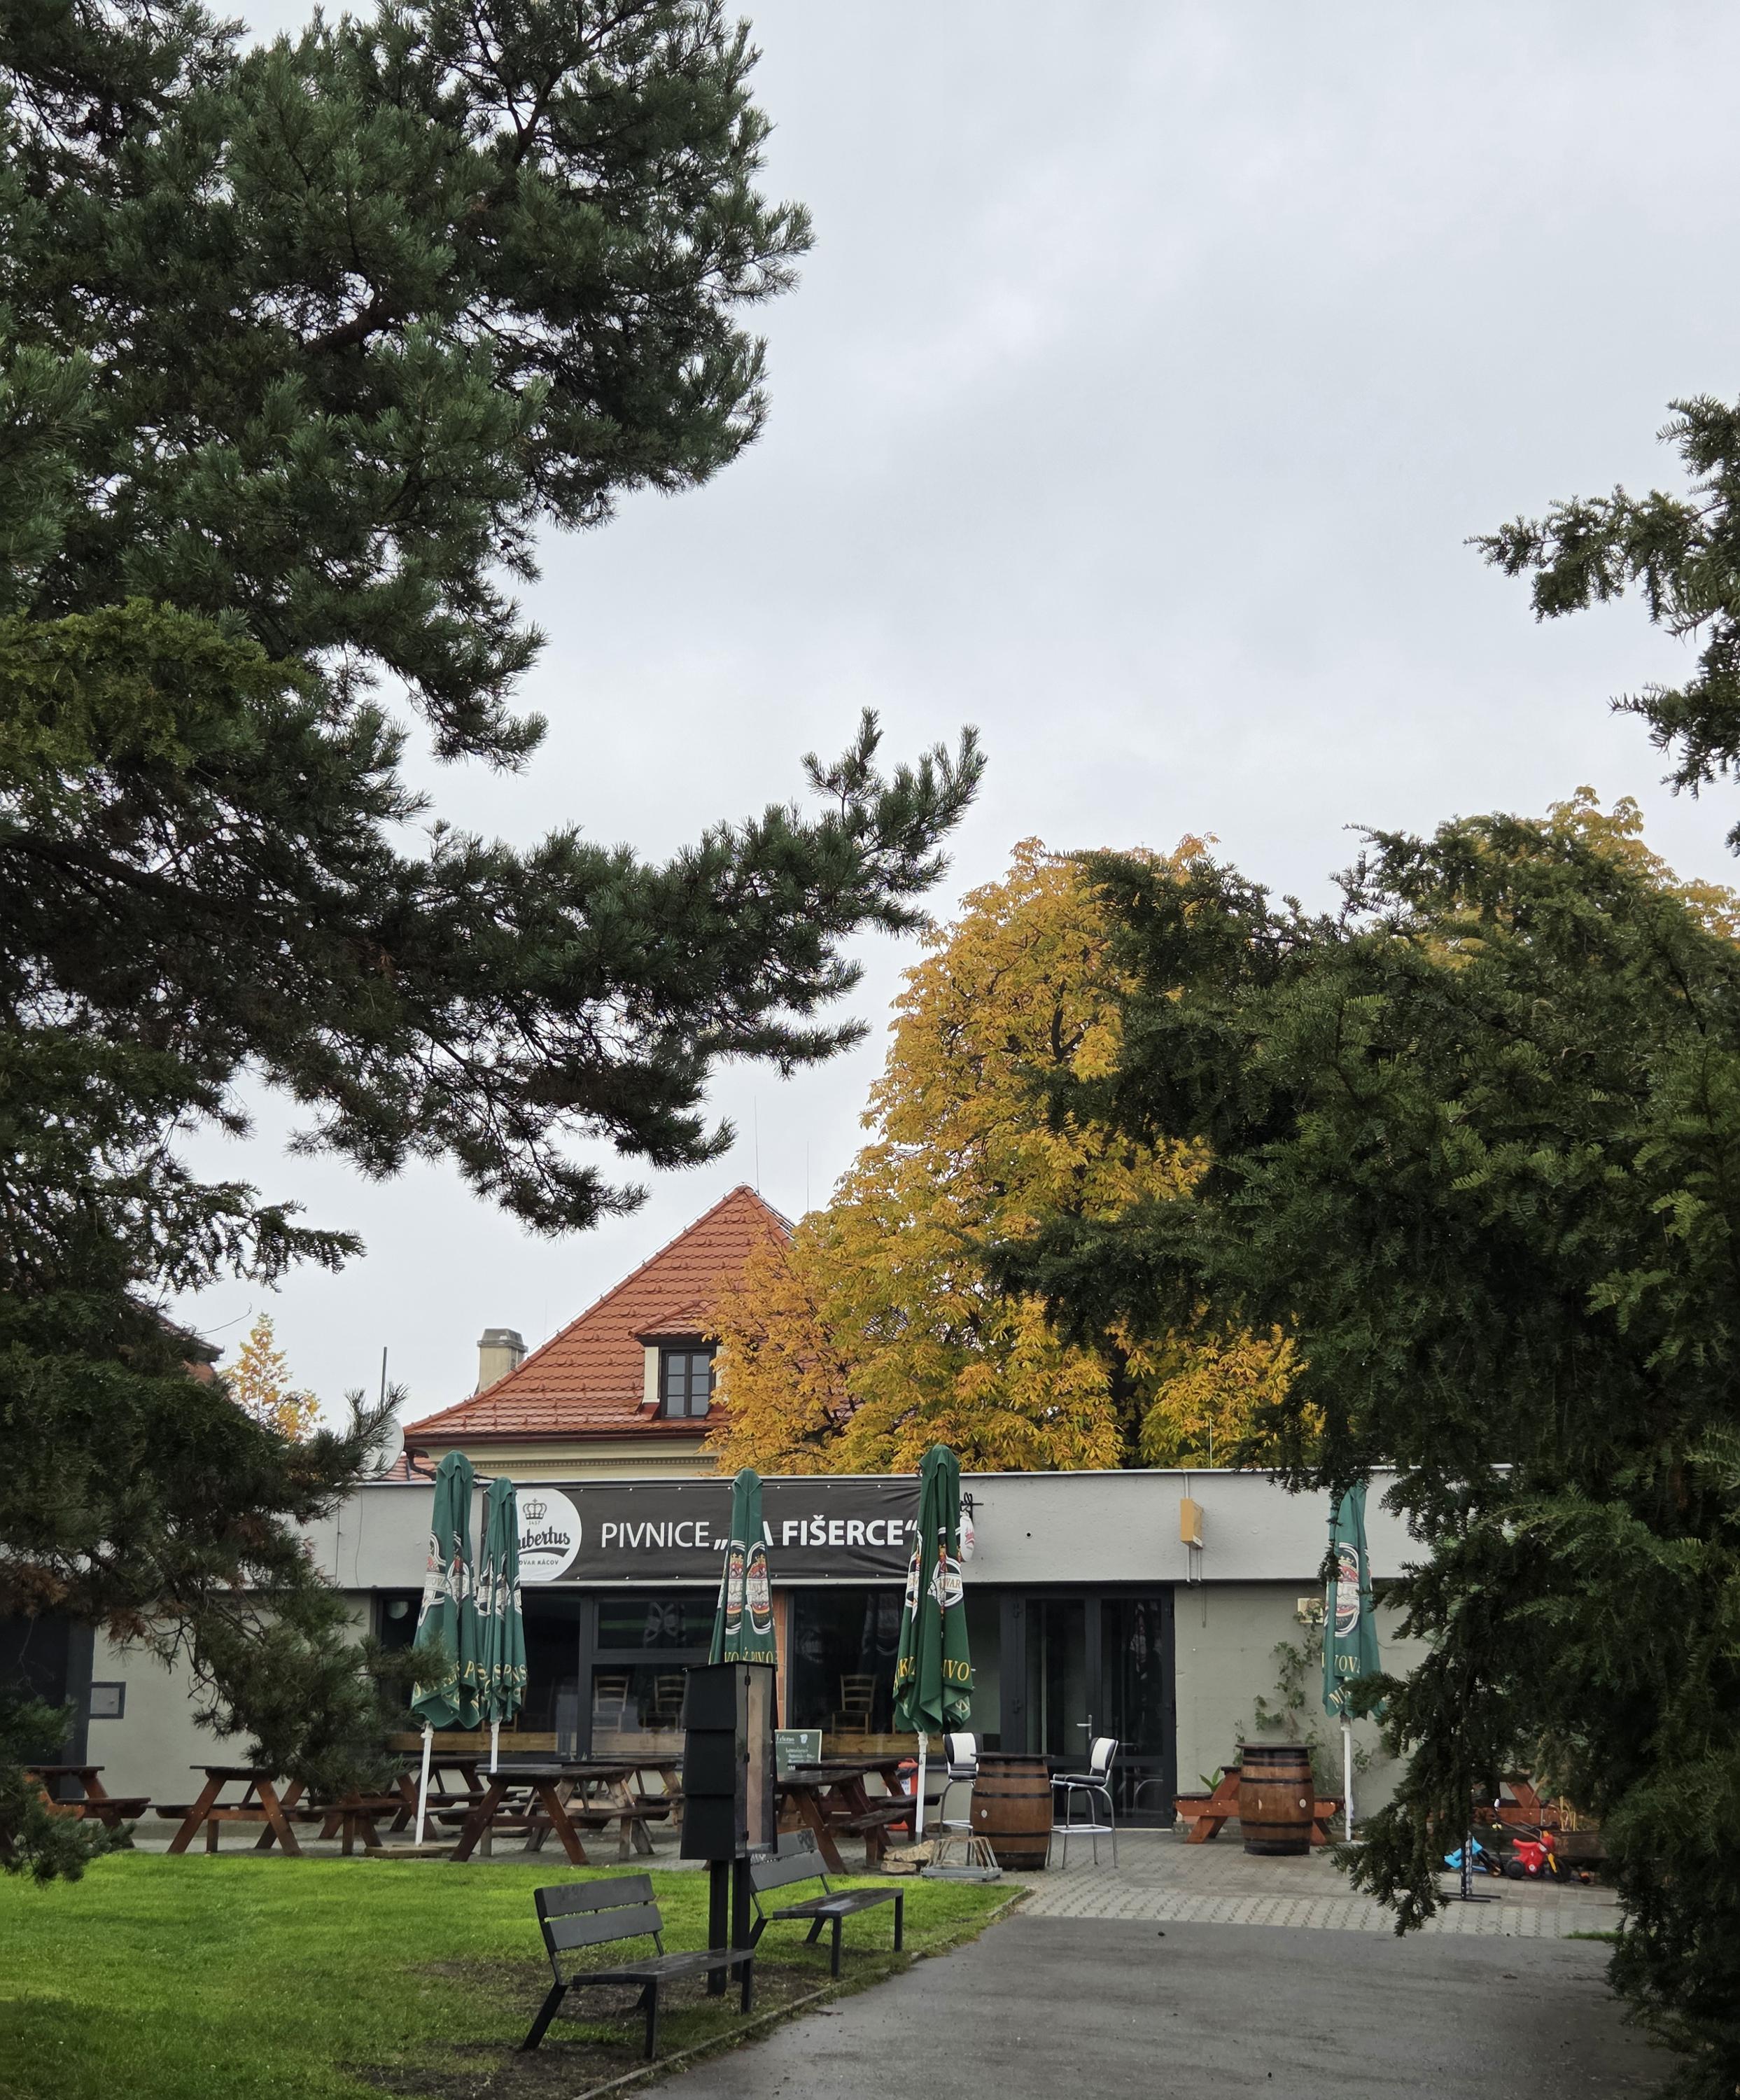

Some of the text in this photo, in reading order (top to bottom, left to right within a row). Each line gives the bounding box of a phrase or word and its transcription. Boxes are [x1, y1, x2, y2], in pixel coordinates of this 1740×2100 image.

[517, 1525, 571, 1550] ubertus
[601, 1520, 710, 1548] PIVNICE
[782, 1515, 918, 1546] FIŠERCE“
